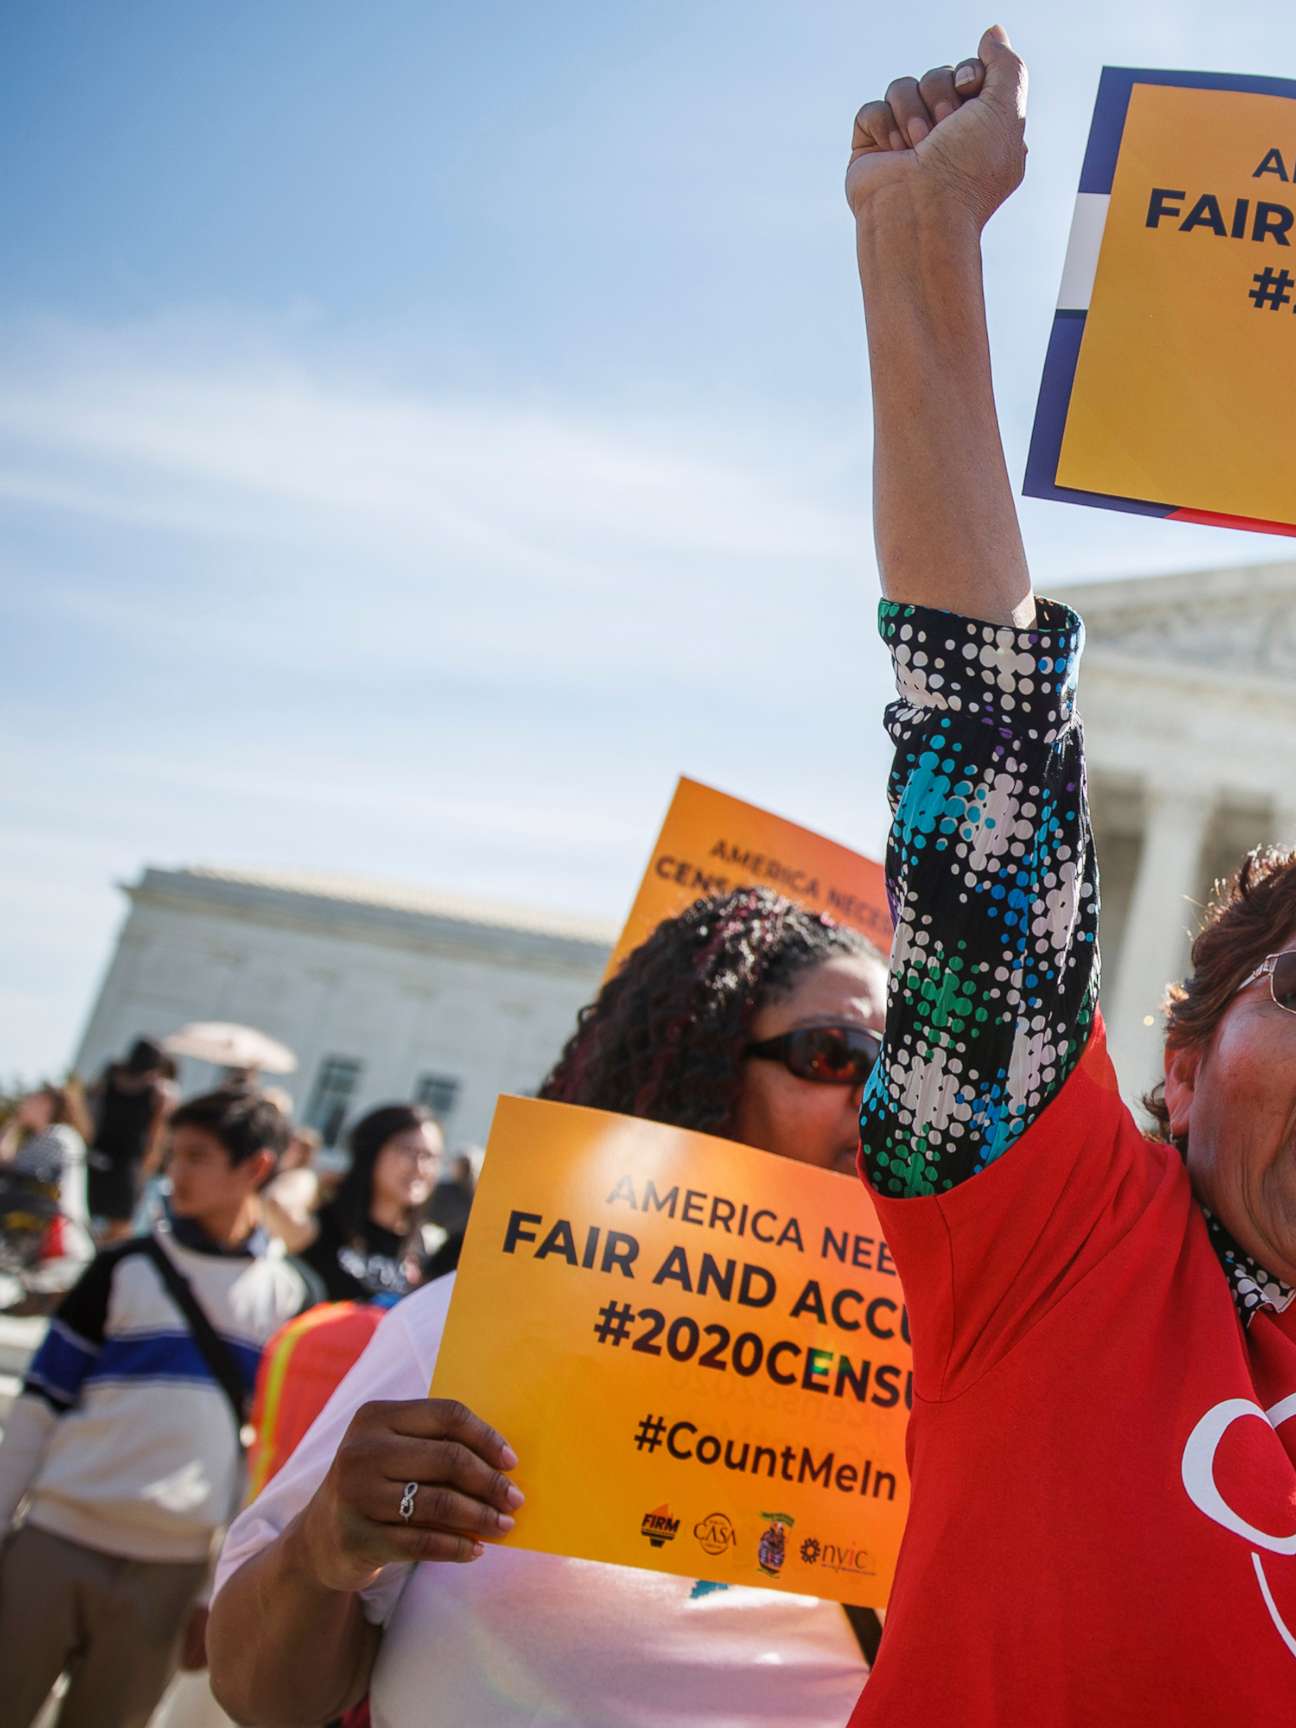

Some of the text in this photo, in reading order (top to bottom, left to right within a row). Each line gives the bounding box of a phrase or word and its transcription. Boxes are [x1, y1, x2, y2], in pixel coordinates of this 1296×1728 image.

[1145, 188, 1293, 246] FAIR
[709, 839, 821, 900] AMERICA
[607, 1175, 804, 1252] AMERICA
[502, 1210, 912, 1345] FAIR AND ACC
[593, 1300, 913, 1411] #2020CENS
[633, 1414, 897, 1501] #CountMeIn
[641, 1513, 681, 1533] FIRM
[693, 1523, 737, 1546] CASA
